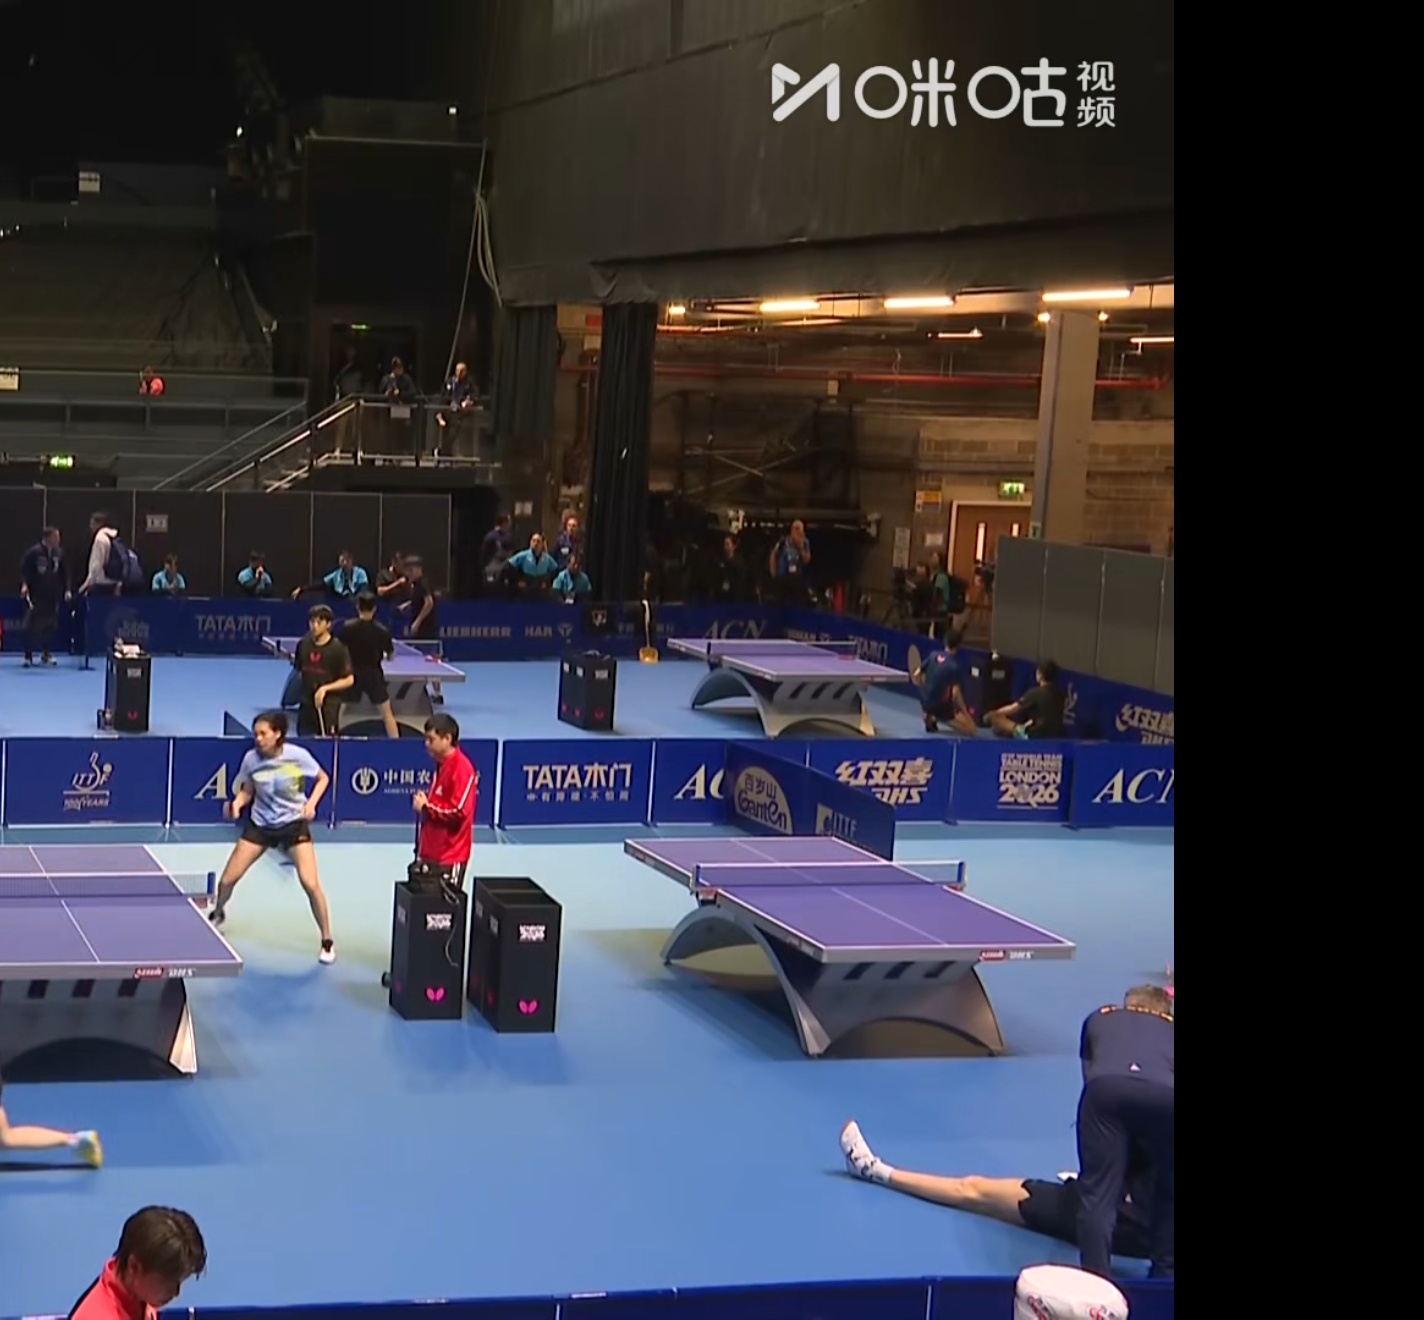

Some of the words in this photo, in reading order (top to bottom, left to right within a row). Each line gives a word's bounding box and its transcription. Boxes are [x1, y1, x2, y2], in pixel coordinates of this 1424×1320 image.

[523, 763, 631, 789] TATA木门
[744, 773, 776, 800] 百岁山
[999, 771, 1061, 783] LONDON
[998, 783, 1060, 805] 2026
